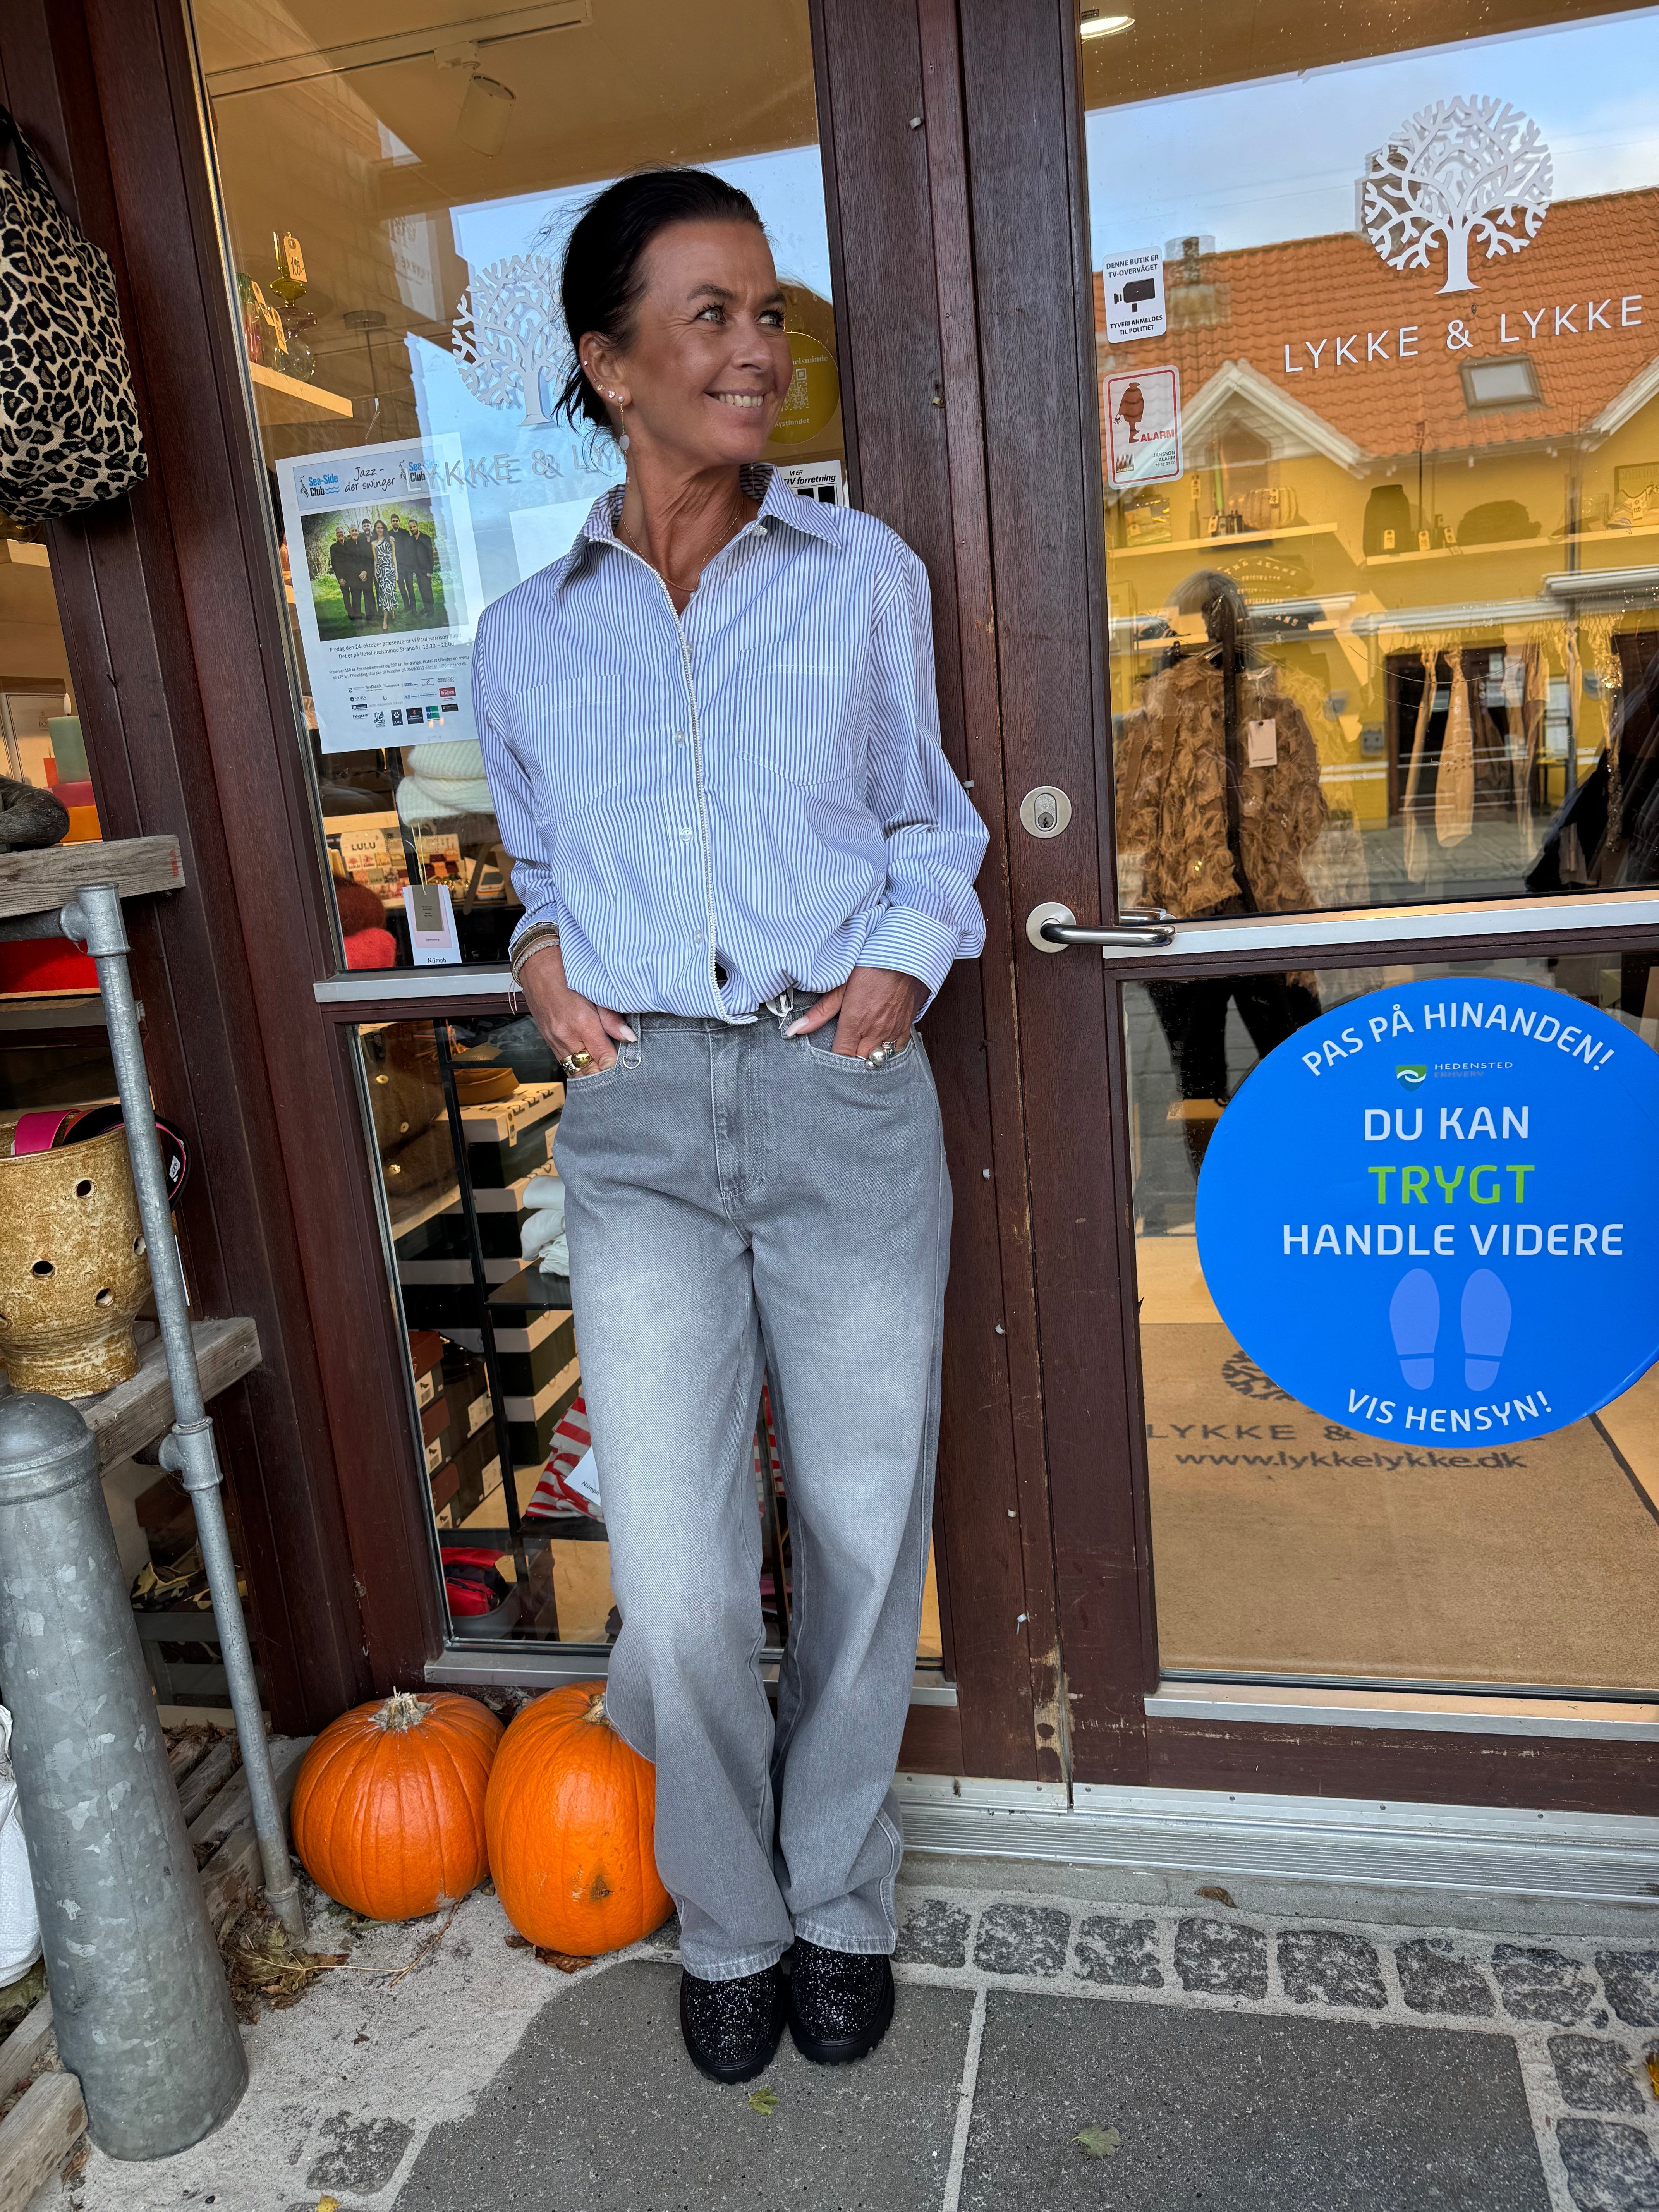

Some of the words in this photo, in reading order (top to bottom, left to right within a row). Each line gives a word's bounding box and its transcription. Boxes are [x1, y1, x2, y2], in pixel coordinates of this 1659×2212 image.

[1106, 260, 1128, 269] DENNE
[1130, 256, 1149, 265] BUTIK
[1108, 264, 1158, 278] TV-OVERVÅGET
[1110, 321, 1130, 329] TYVERI
[1132, 315, 1163, 325] ANMELDES
[1129, 325, 1154, 333] POLITIET
[1284, 326, 1419, 373] LYKKE
[1446, 319, 1474, 350] &
[1500, 294, 1642, 344] LYKKE
[1140, 429, 1175, 442] ALARM
[354, 467, 377, 481] Jazz
[405, 454, 510, 492] LYKKE
[531, 449, 550, 476] &
[410, 471, 426, 482] Club
[308, 474, 338, 486] Sea-Side
[345, 481, 359, 493] der
[362, 477, 395, 491] swinger
[797, 474, 836, 484] forretning
[310, 486, 325, 497] Club
[352, 842, 376, 851] LULU
[1302, 1027, 1364, 1076] PAS
[1368, 1003, 1415, 1042] PÅ
[1424, 1002, 1615, 1071] HINANDEN!
[1435, 1062, 1513, 1070] HEDENSTED
[1364, 1108, 1423, 1141] DU
[1439, 1106, 1529, 1140] KAN
[1368, 1164, 1535, 1204] TRYGT
[1283, 1224, 1455, 1256] HANDLE
[1469, 1223, 1624, 1256] VIDERE
[1348, 1388, 1396, 1424] VIS
[1405, 1390, 1552, 1432] HENSYN!
[1146, 1424, 1296, 1440] LYKKE
[1323, 1425, 1357, 1441] &
[1176, 1451, 1527, 1470] www.lykkelykke.dk
